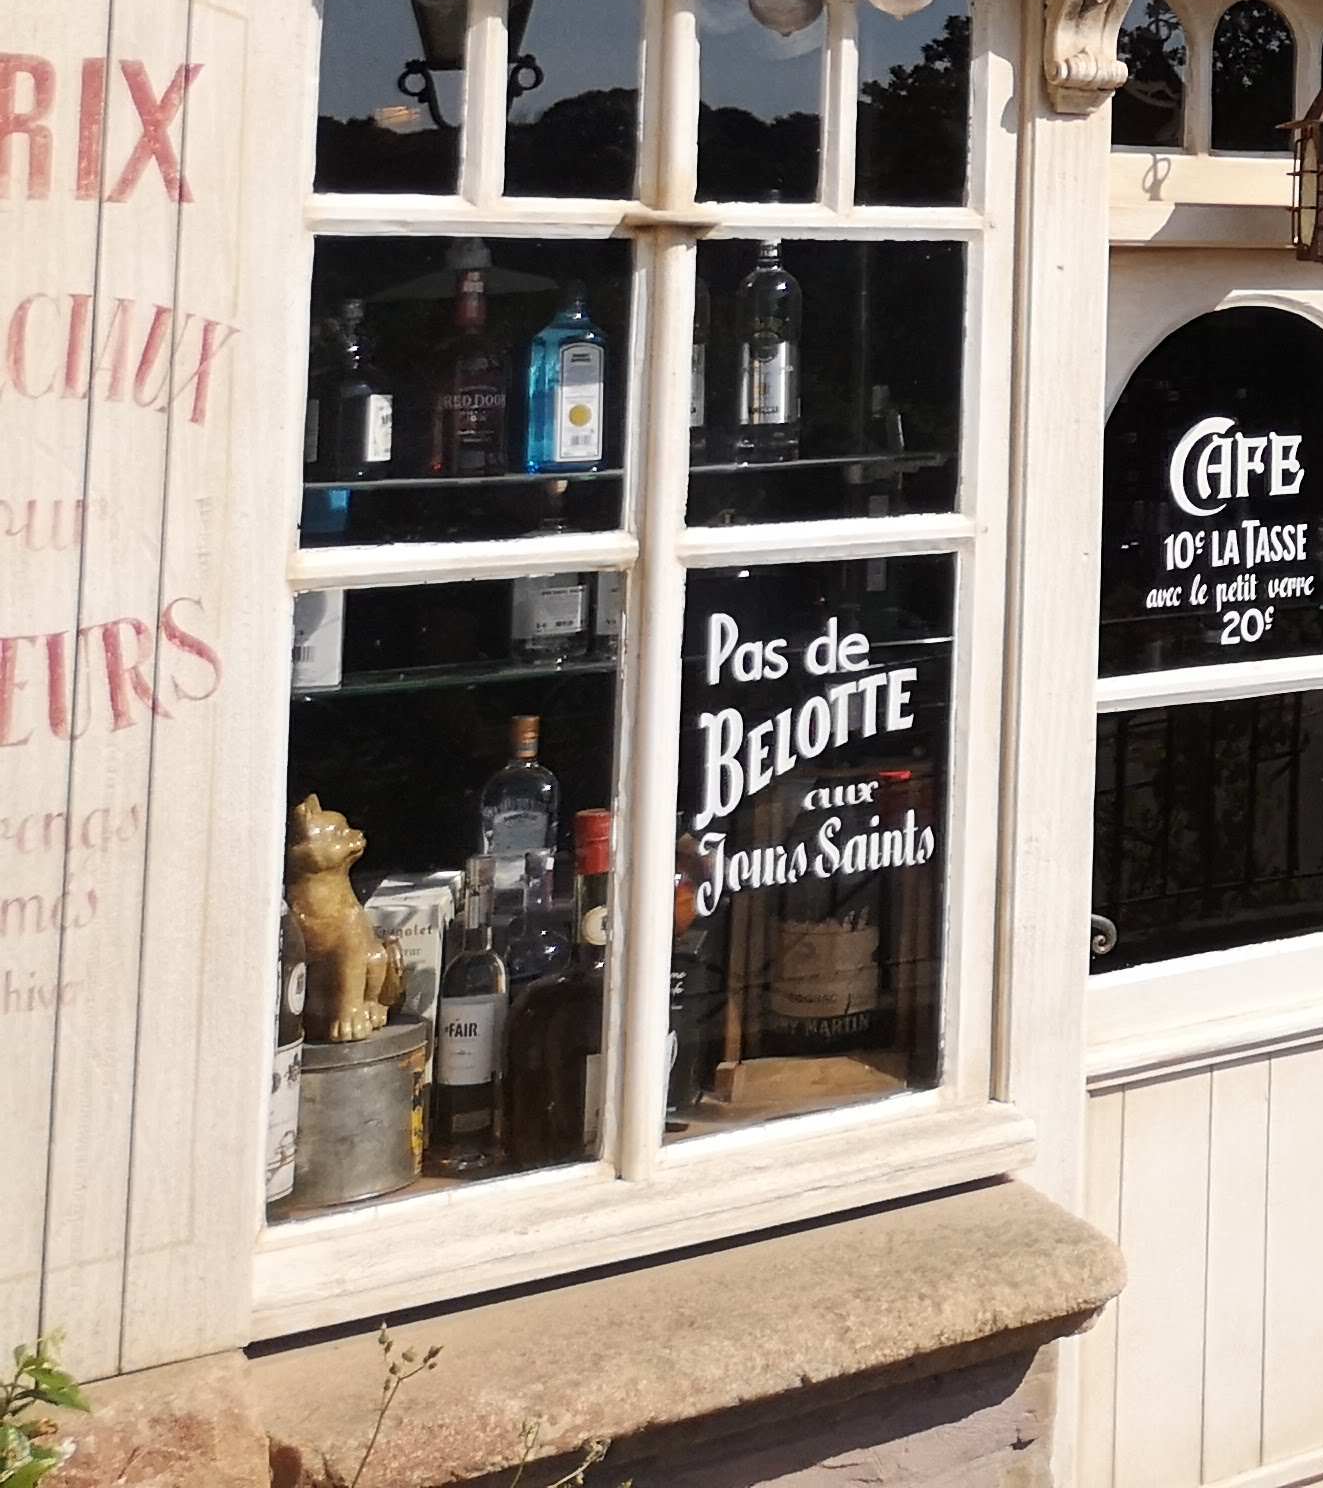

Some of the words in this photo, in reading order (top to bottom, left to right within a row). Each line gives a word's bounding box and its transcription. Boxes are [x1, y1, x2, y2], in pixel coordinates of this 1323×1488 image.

[1212, 530, 1240, 567] LA
[1146, 585, 1182, 608] avec
[1189, 574, 1208, 606] le
[1216, 574, 1257, 612] petit
[1268, 575, 1315, 599] verre
[706, 613, 788, 685] Pas
[805, 617, 870, 675] de
[693, 668, 917, 830] BELOTTE
[803, 780, 879, 811] aux
[814, 809, 936, 878] Saints
[449, 1022, 478, 1038] FAIR
